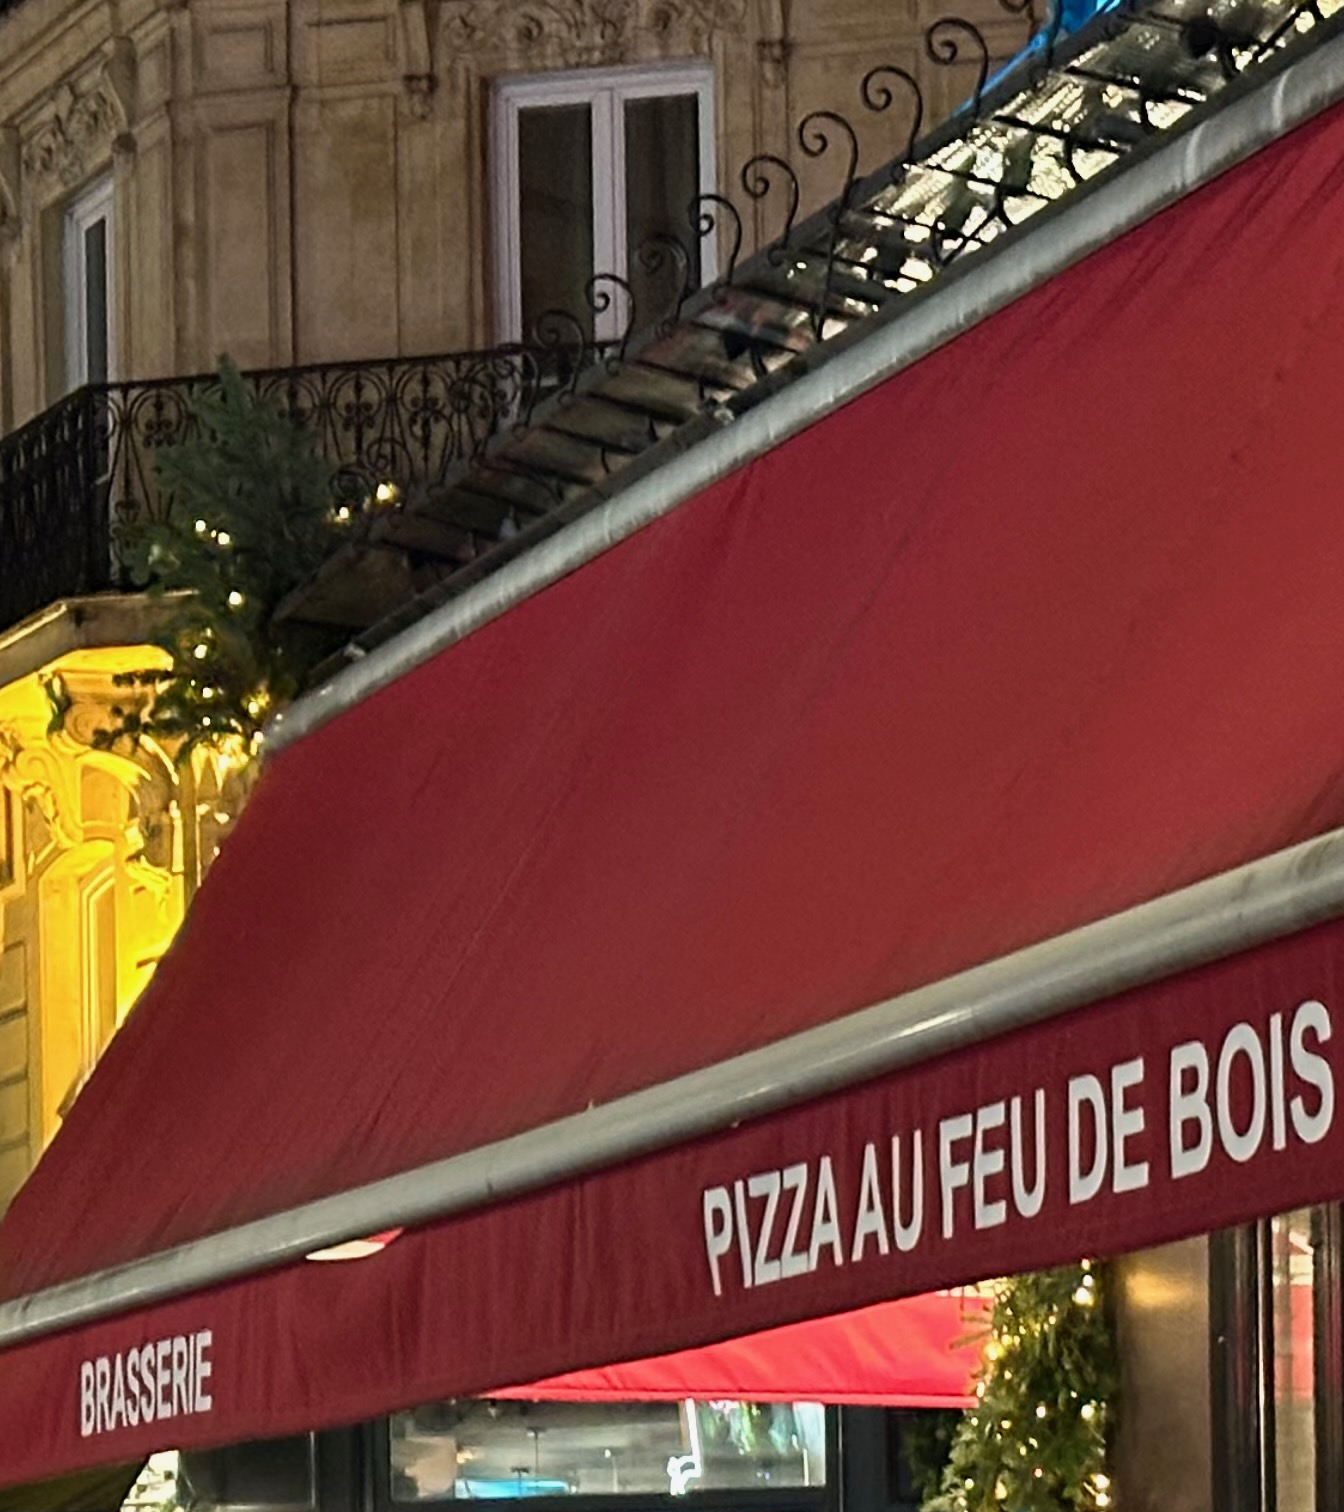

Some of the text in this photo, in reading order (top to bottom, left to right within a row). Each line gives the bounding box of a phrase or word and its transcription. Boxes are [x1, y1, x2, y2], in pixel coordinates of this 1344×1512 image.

[703, 999, 1336, 1297] PIZZA AU FEU DE BOIS
[81, 1328, 213, 1438] BRASSERIE
